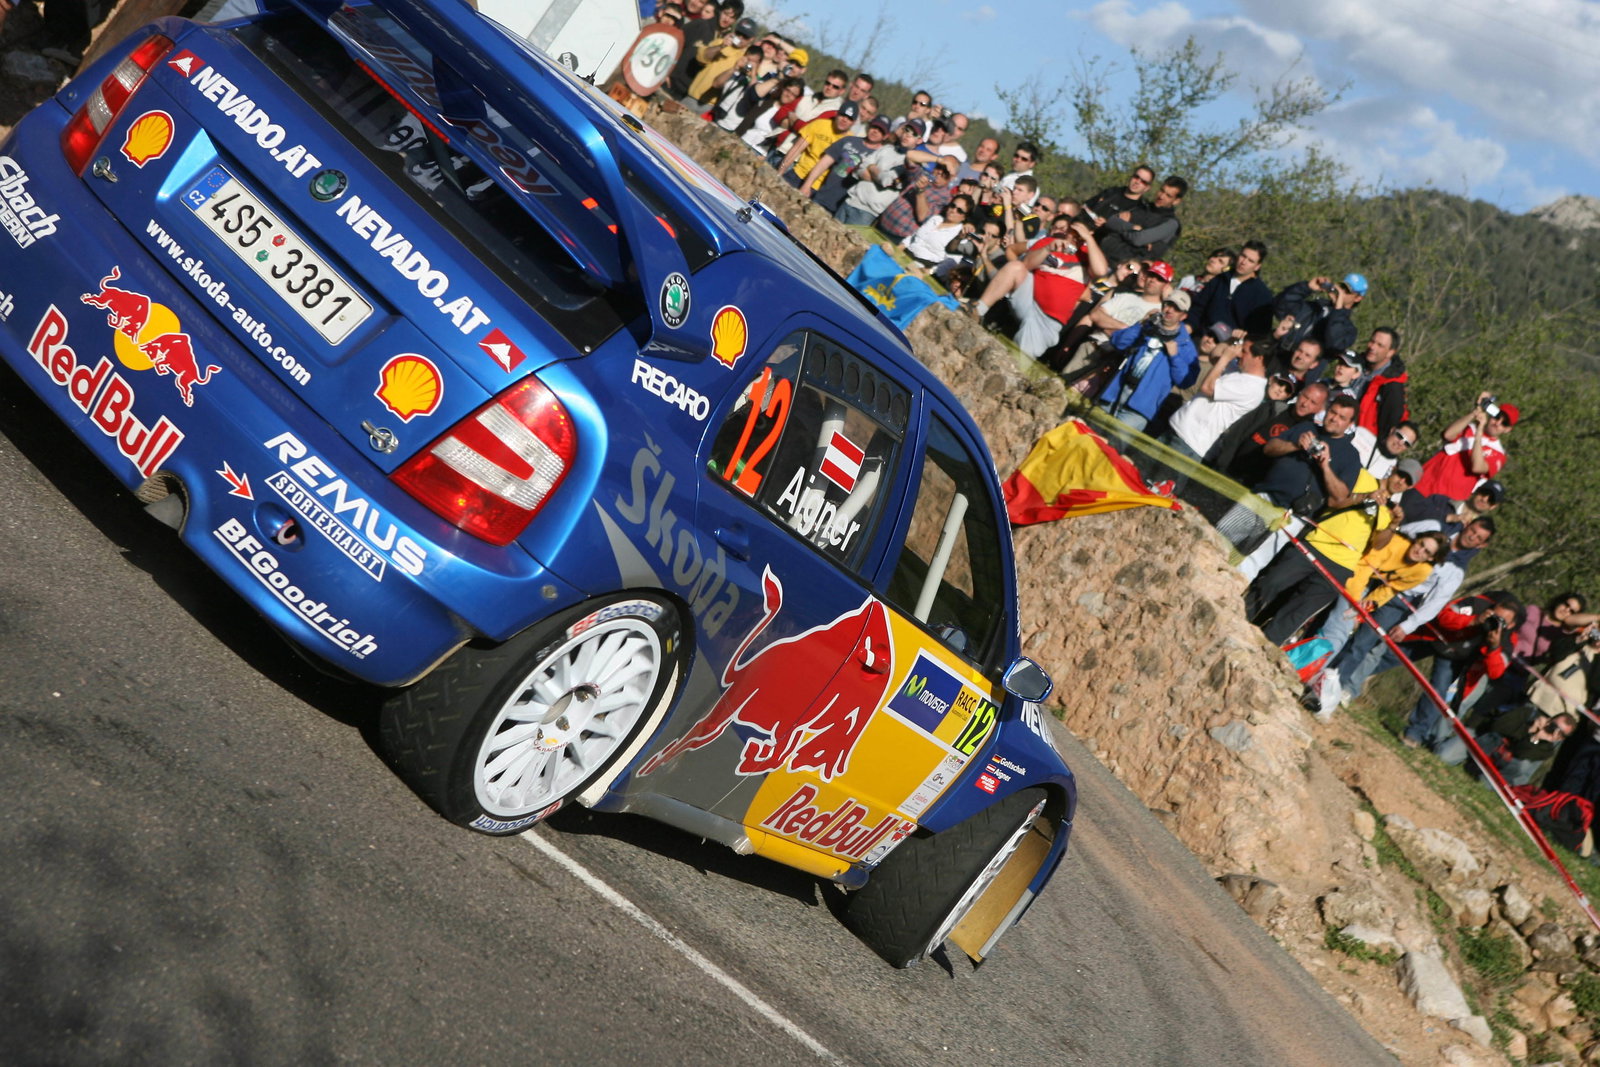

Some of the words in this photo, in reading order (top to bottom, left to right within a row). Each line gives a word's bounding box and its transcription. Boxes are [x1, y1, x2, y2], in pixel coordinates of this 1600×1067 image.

[190, 66, 322, 178] NEVADO.AT
[188, 188, 206, 206] CZ
[146, 219, 312, 387] www.skoda-auto.com
[210, 193, 273, 247] 4S5
[270, 248, 352, 326] 3381
[336, 196, 491, 336] NEVADO.AT
[631, 359, 710, 421] RECARO
[722, 366, 792, 498] 12
[263, 431, 428, 576] REMUS
[274, 475, 383, 577] SPORTEXHAUST
[776, 466, 861, 552] Aigner
[214, 517, 378, 656] BFGoodrich
[955, 691, 977, 714] RACC
[955, 701, 996, 755] 12
